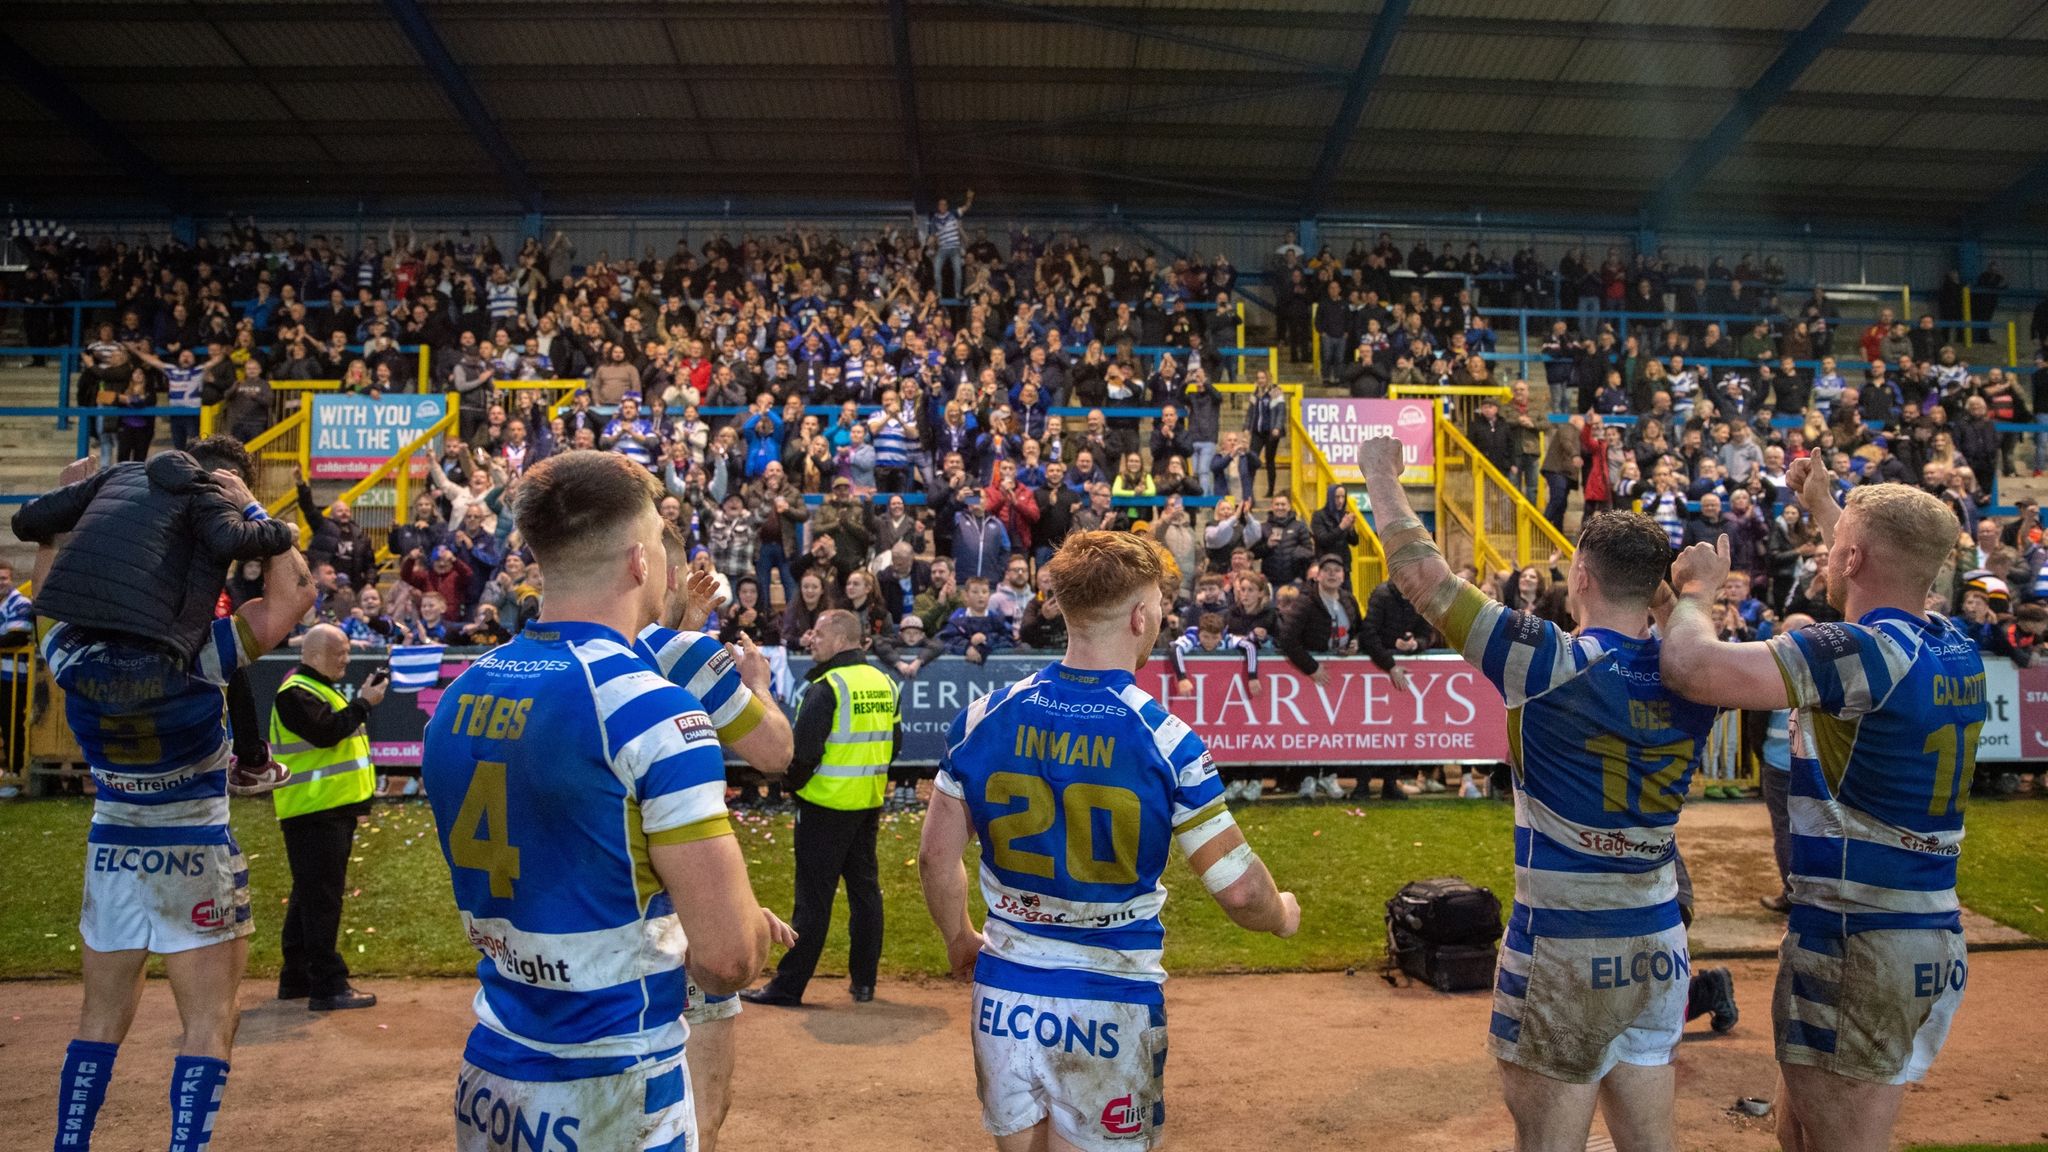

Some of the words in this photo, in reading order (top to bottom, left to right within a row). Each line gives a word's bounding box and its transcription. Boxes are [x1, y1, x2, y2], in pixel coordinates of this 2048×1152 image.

[320, 404, 367, 426] WITH
[373, 404, 411, 426] YOU
[1307, 404, 1339, 422] FOR
[1345, 405, 1357, 422] A
[318, 428, 352, 449] ALL
[357, 429, 390, 449] THE
[1307, 424, 1394, 442] HEALTHIER
[472, 653, 571, 672] ABARCODES
[1609, 660, 1661, 682] ABARCO
[854, 702, 894, 715] RESPONSE
[1021, 690, 1127, 717] ABARCODES
[1157, 672, 1476, 726] HARVEYS
[100, 715, 162, 765] 3
[370, 746, 420, 757] n.co.uk
[1014, 724, 1116, 768] INMAN
[1201, 734, 1276, 750] HALIFAX
[1282, 733, 1408, 750] DEPARTMENT
[1414, 732, 1475, 749] STORE
[1585, 734, 1695, 814] 12
[449, 760, 520, 899] 4
[985, 771, 1142, 885] 20
[94, 847, 205, 877] ELCONS
[1591, 948, 1690, 990] ELCON
[979, 997, 1120, 1060] ELCONS
[455, 1074, 580, 1152] LCONS
